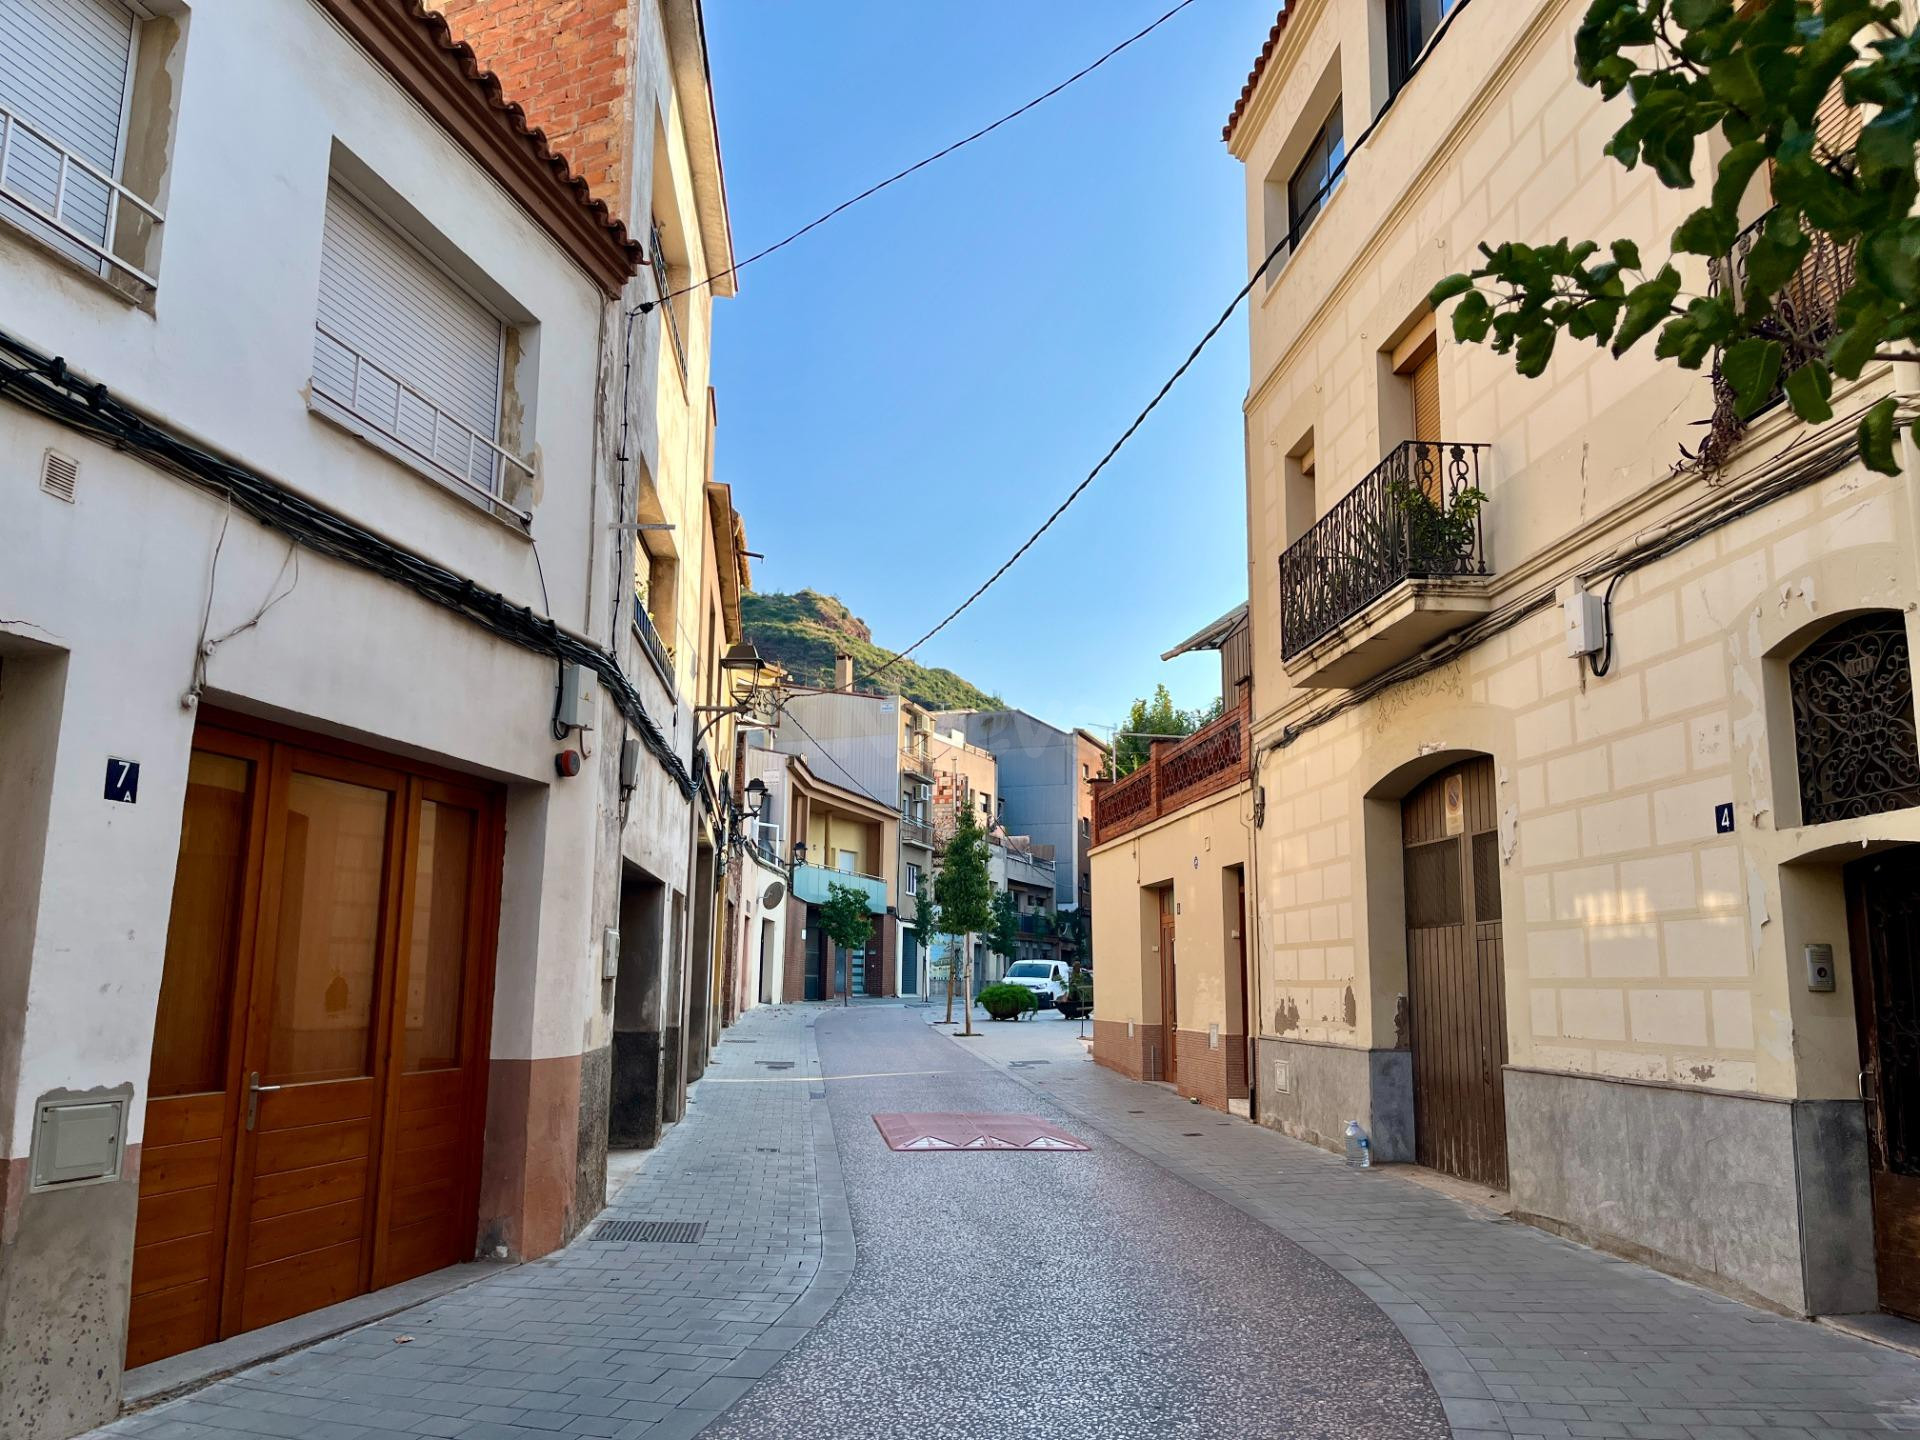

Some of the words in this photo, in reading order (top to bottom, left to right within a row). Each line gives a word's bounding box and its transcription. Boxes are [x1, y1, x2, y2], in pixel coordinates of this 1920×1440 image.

[116, 761, 131, 788] 7
[123, 790, 132, 802] A
[1721, 807, 1730, 827] 4
